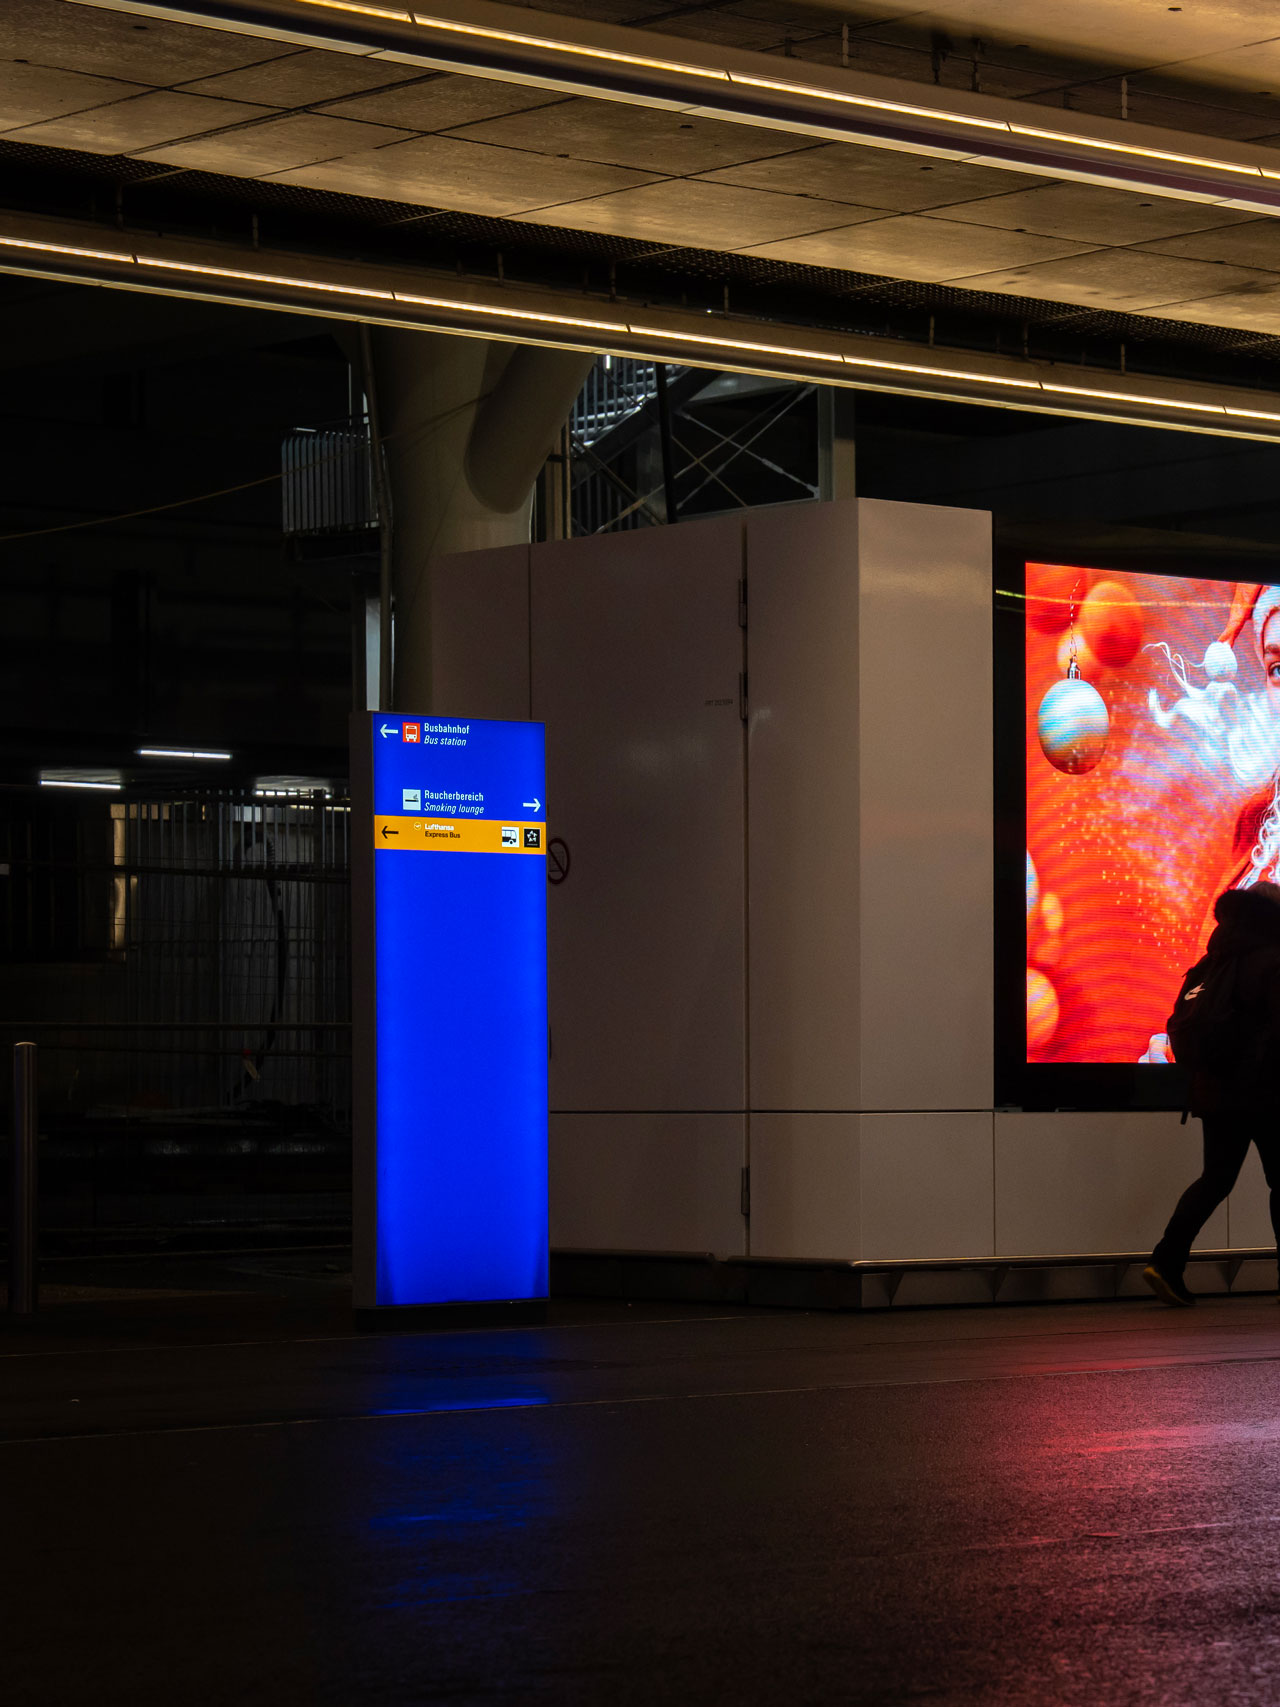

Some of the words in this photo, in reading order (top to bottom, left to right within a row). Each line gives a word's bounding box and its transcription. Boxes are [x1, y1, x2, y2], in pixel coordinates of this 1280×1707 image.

[424, 723, 470, 734] Busbahnhof
[424, 735, 438, 745] Bus
[440, 737, 467, 746] station
[424, 790, 484, 801] Raucherbereich
[424, 802, 457, 814] Smoking
[458, 804, 485, 815] lounge
[425, 823, 454, 831] Lufthansa
[425, 831, 448, 839] Express
